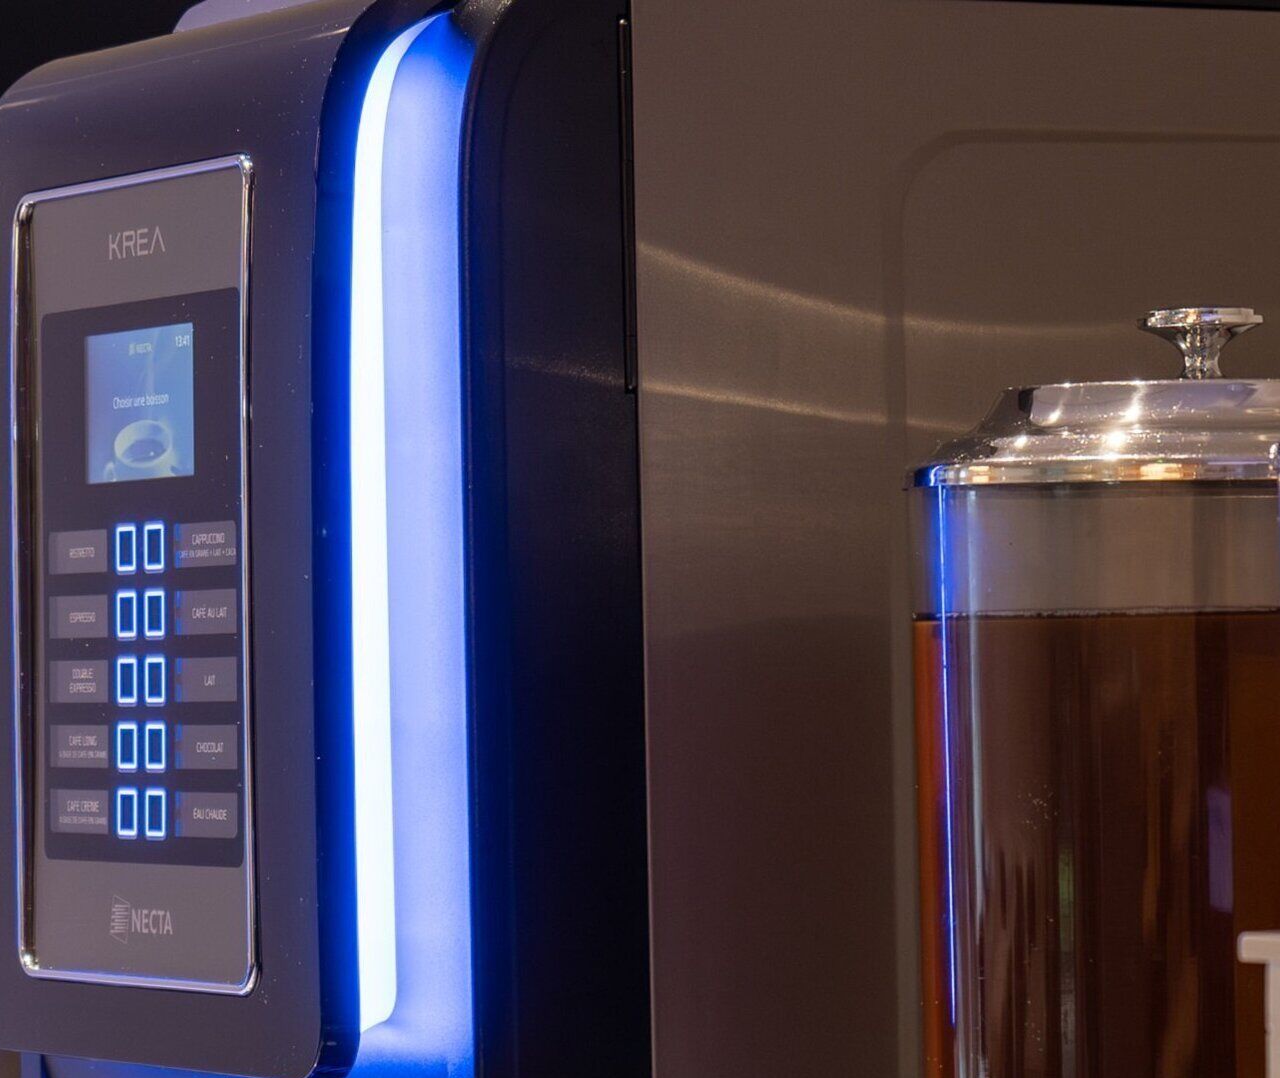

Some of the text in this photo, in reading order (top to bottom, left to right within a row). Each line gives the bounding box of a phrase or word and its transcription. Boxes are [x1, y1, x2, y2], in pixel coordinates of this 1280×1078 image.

[108, 225, 166, 260] KREA
[207, 607, 216, 618] AU
[216, 606, 228, 618] LAIT
[196, 741, 224, 753] CHOCOLAT
[193, 807, 227, 821] EAU CHAUDE
[131, 908, 173, 935] NECTA
